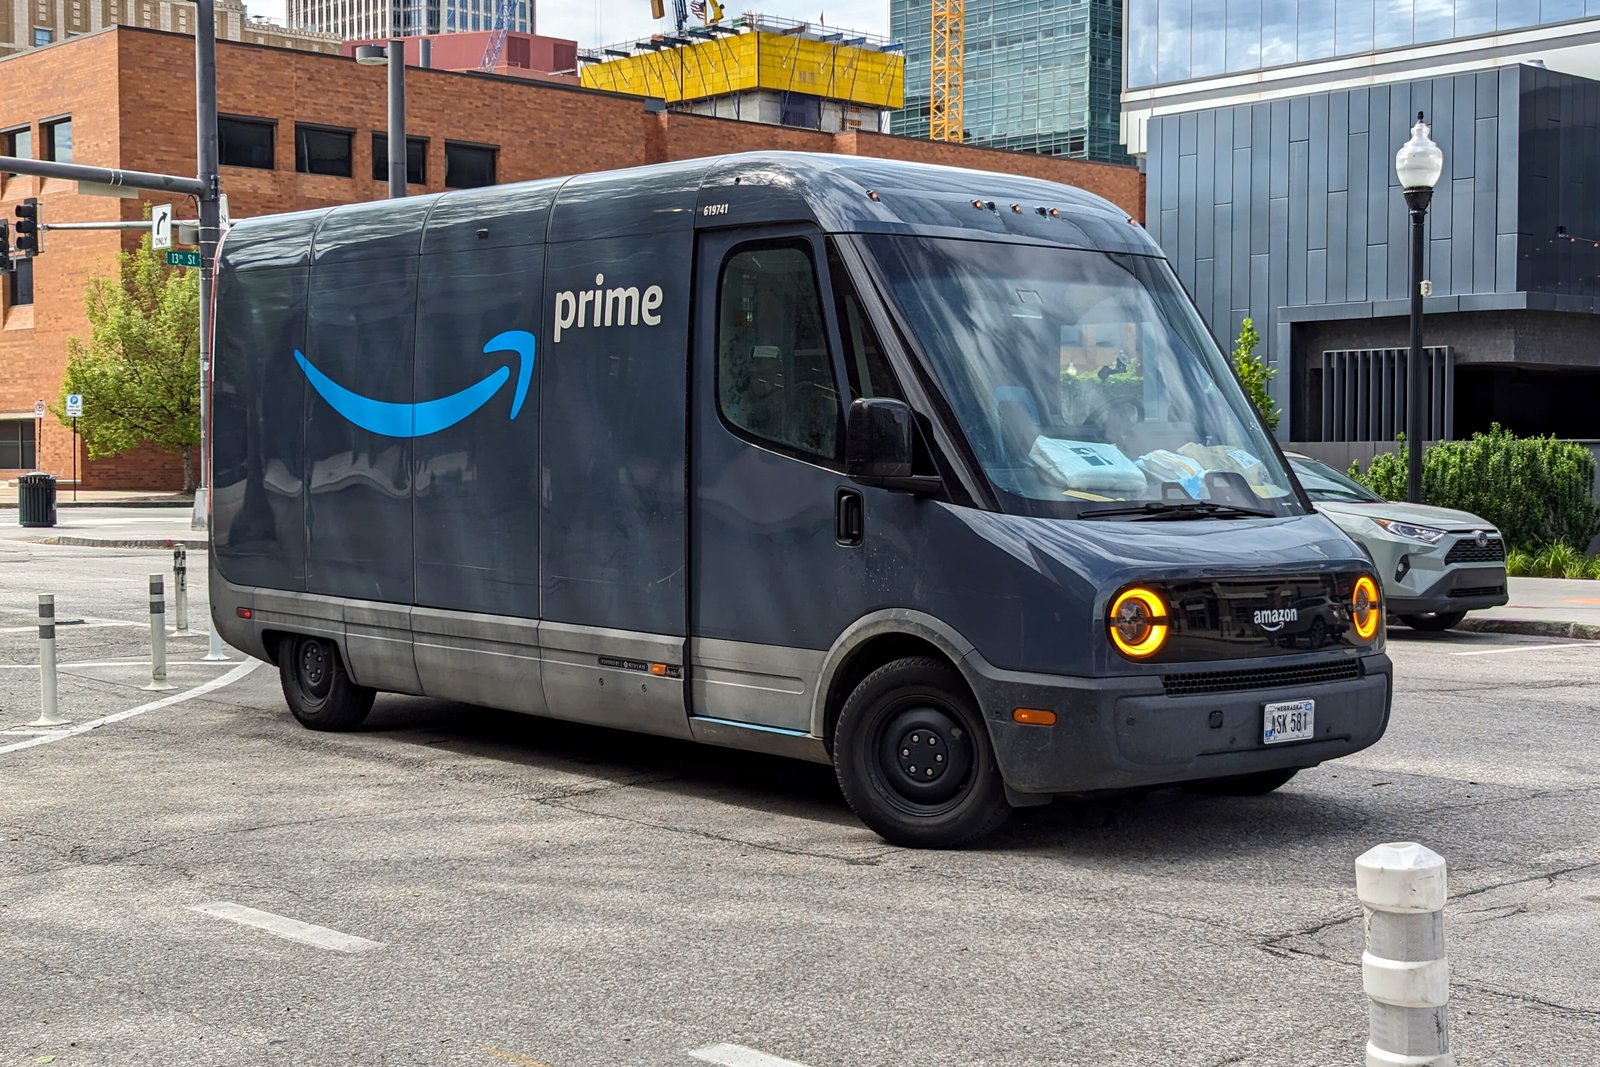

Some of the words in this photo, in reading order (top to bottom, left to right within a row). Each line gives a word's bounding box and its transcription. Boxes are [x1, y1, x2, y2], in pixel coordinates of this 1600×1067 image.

[703, 203, 729, 216] 619741
[155, 236, 168, 246] ONLY
[187, 254, 196, 265] St
[554, 273, 663, 343] prime
[1253, 608, 1298, 624] amazon
[628, 662, 646, 670] RIVIAN
[1272, 713, 1288, 735] ASK
[1290, 711, 1307, 732] 581
